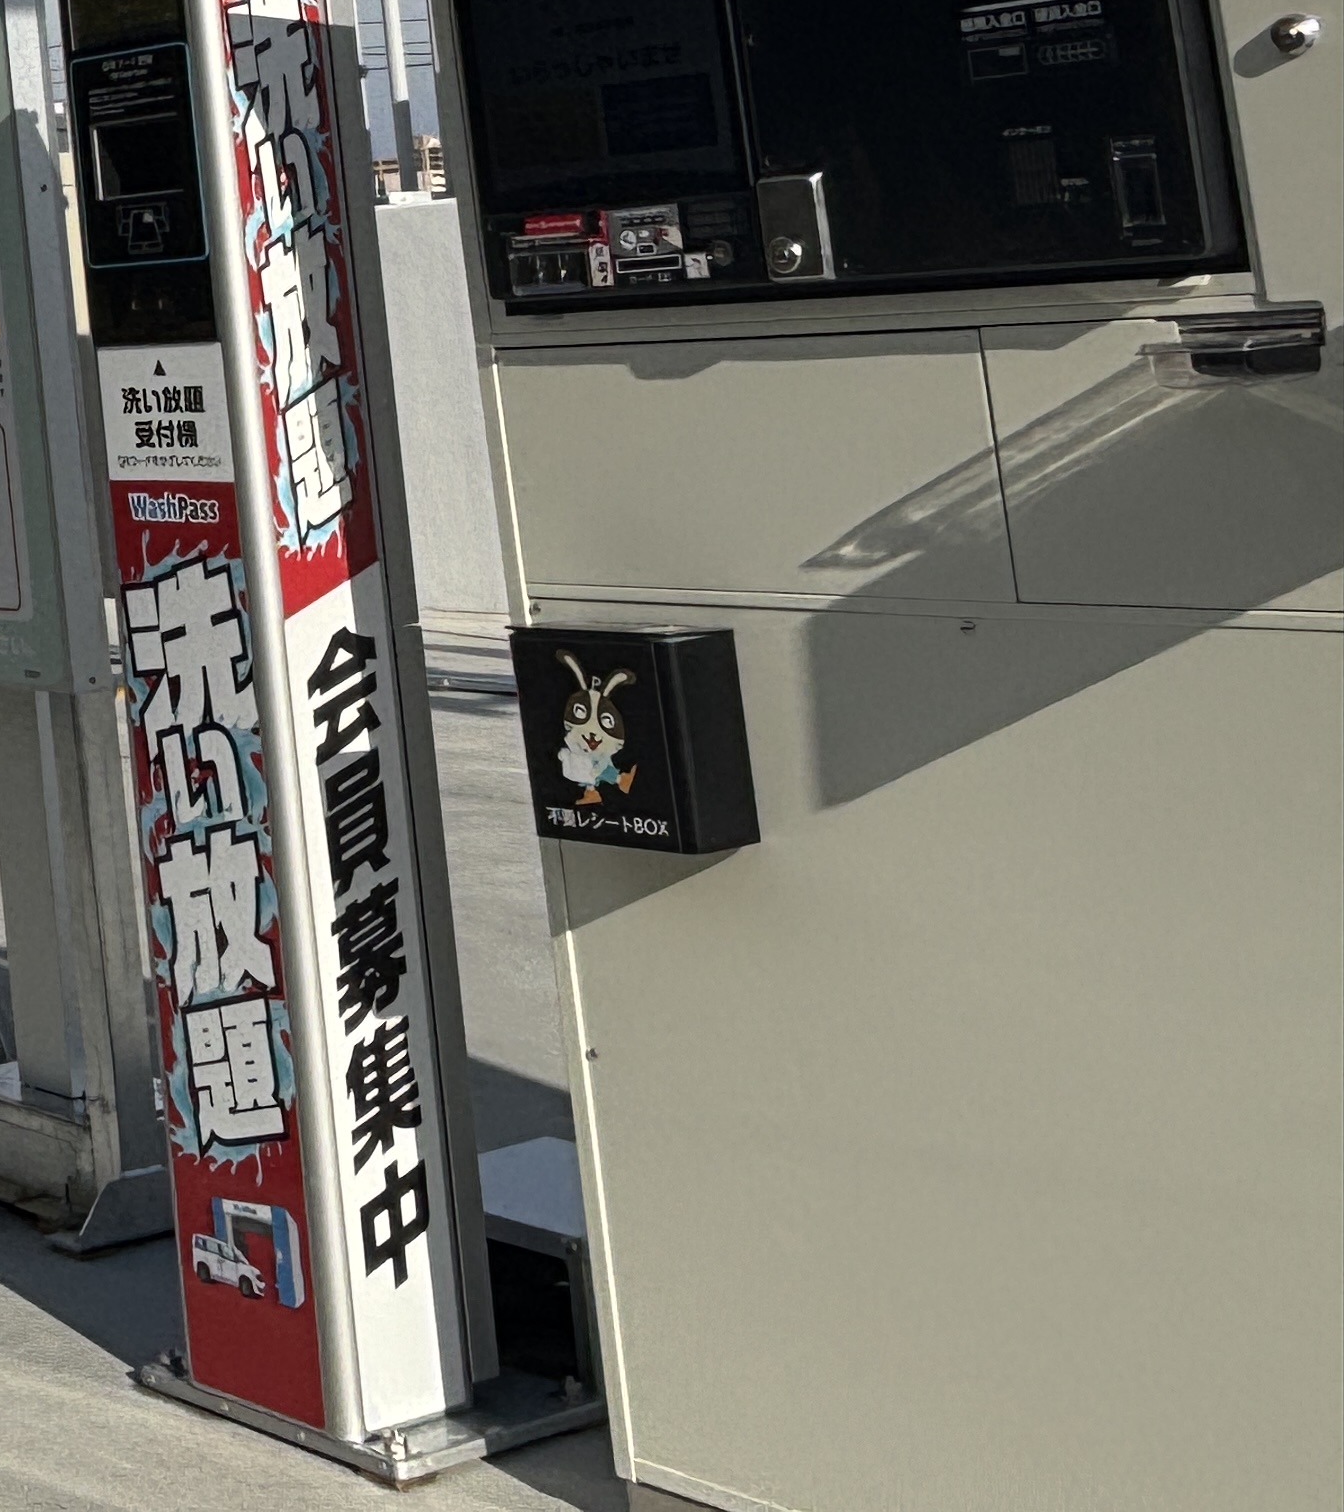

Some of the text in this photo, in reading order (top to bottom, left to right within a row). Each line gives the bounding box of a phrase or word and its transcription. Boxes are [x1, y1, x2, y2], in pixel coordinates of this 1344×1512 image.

[128, 492, 219, 523] WashPass
[120, 556, 289, 1158] 洗い放題
[307, 626, 430, 1289] 会員募集中
